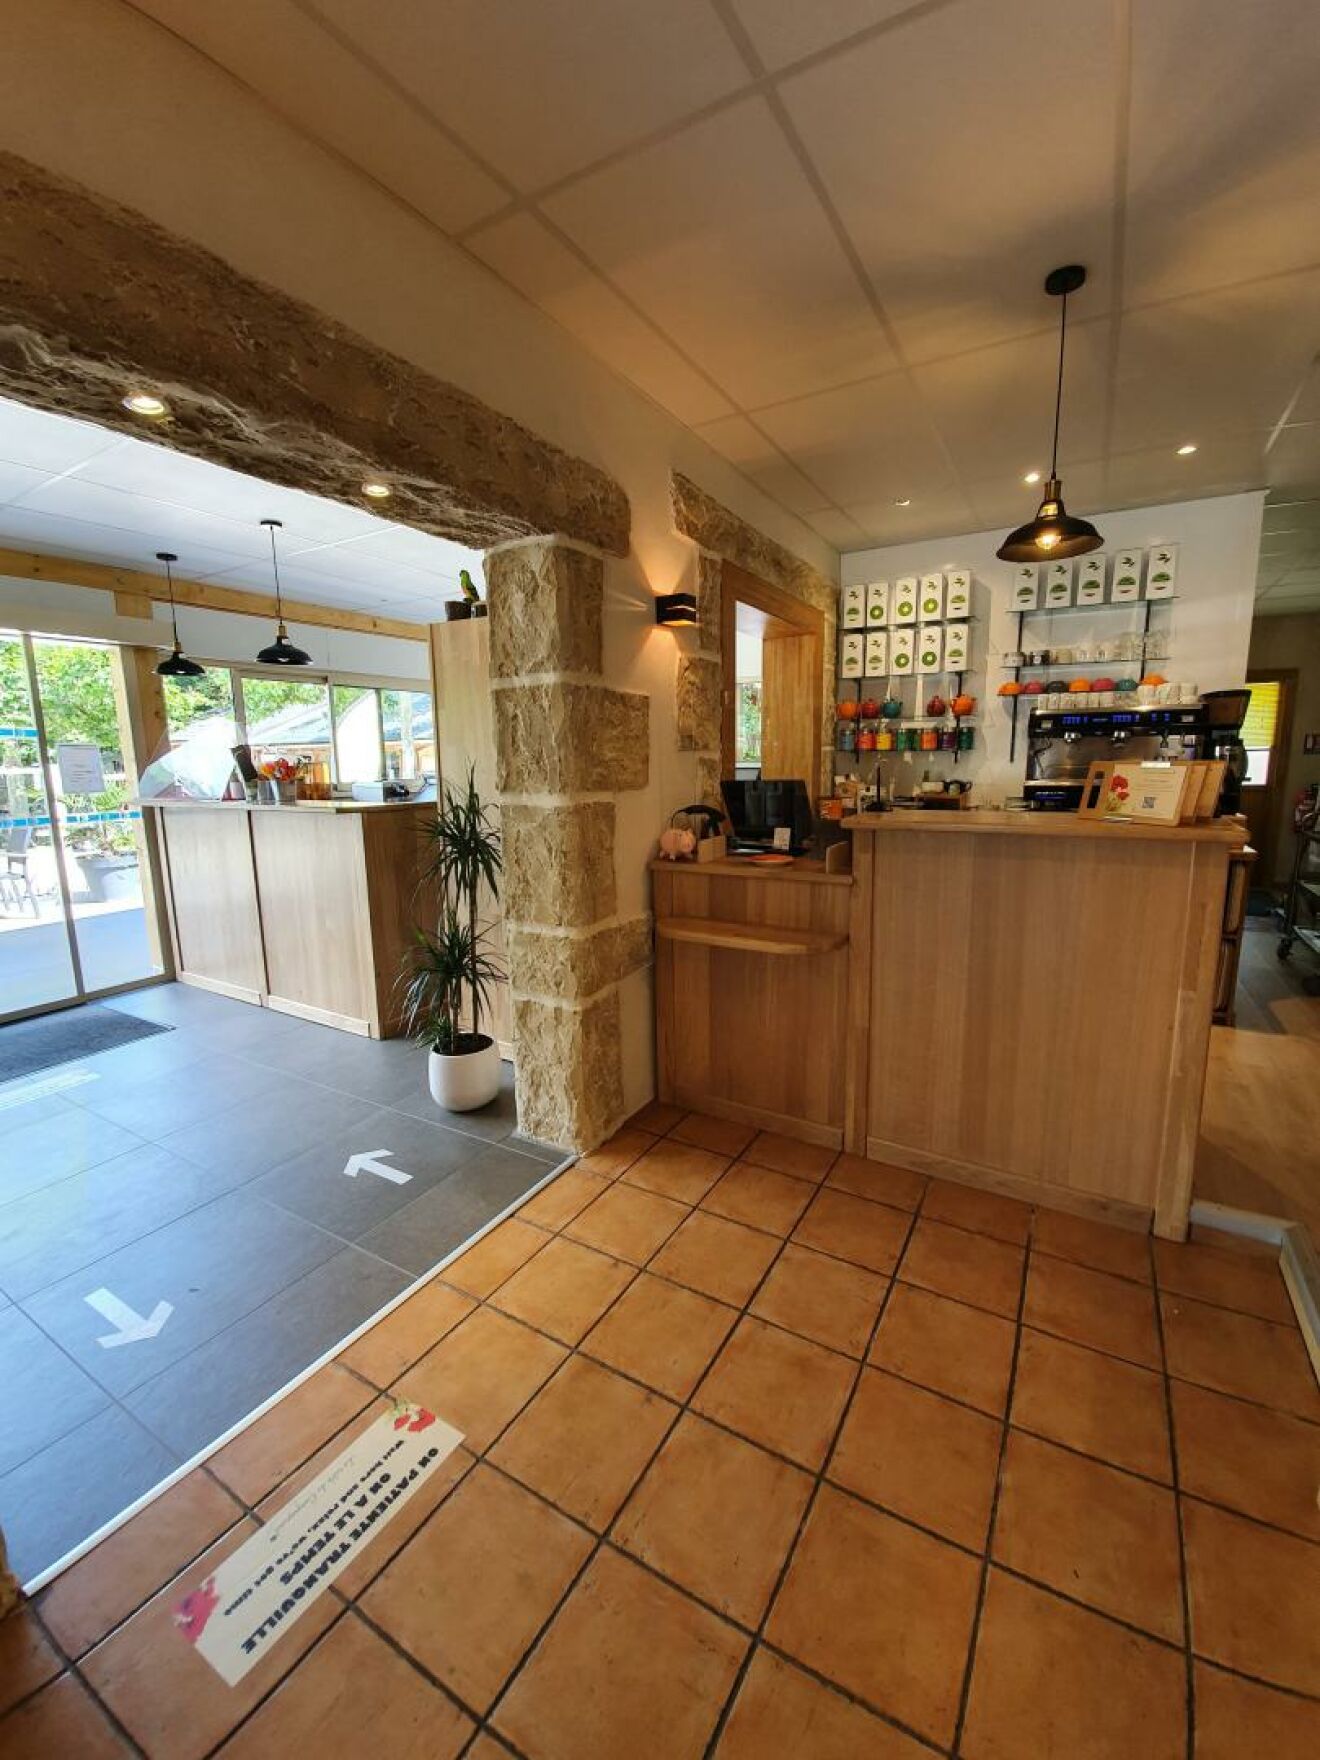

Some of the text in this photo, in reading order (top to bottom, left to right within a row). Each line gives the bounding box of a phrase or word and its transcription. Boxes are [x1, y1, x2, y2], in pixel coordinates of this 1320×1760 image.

[340, 1484, 358, 1503] and
[418, 1448, 438, 1468] ON
[280, 1473, 391, 1585] ON A LE TEMPS
[349, 1469, 419, 1540] PATIENTE
[241, 1542, 351, 1654] TRANQUILLE
